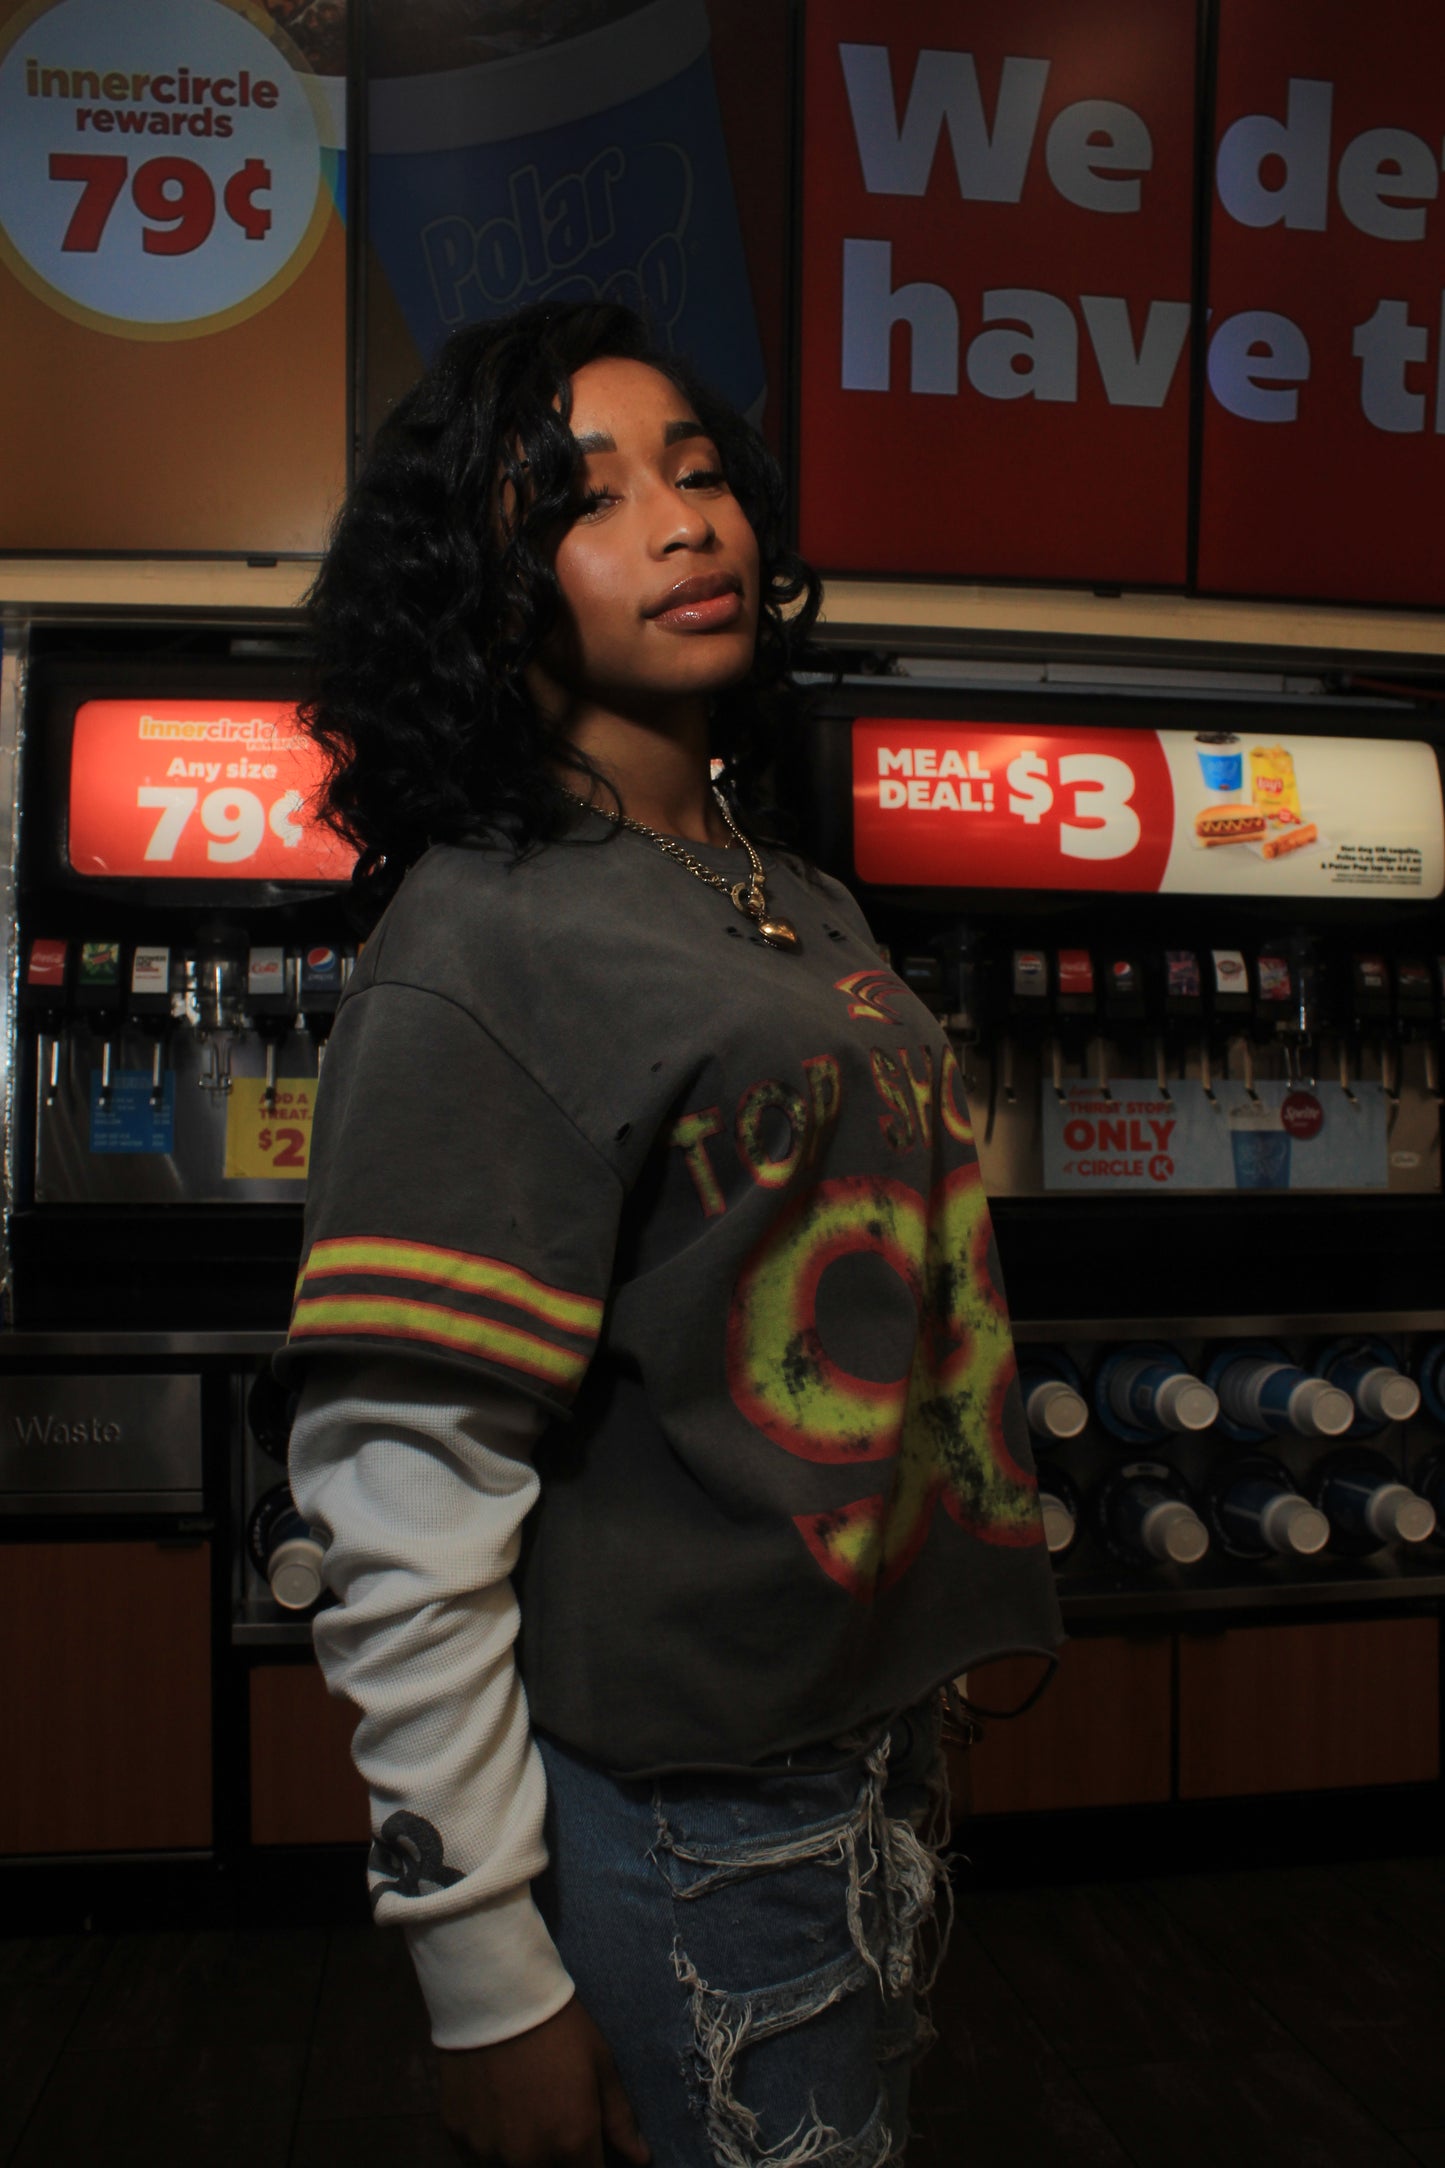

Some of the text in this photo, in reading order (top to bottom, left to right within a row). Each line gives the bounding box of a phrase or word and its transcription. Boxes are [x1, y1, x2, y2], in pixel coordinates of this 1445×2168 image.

[27, 59, 279, 109] innercircle
[76, 107, 234, 138] rewards
[839, 42, 1445, 242] We de
[49, 153, 272, 256] 79¢
[420, 145, 627, 325] Polar
[841, 238, 1310, 423] have
[1353, 290, 1445, 435] t
[138, 715, 278, 743] innercircle
[167, 757, 277, 783] Any size
[877, 747, 991, 779] MEAL
[878, 779, 995, 812] DEAL!
[1007, 750, 1142, 861] $3
[137, 786, 303, 864] 79¢
[297, 1092, 308, 1104] A
[1069, 1101, 1120, 1114] THIRST
[258, 1127, 305, 1167] $2
[668, 1054, 842, 1218] TOP
[1063, 1119, 1176, 1152] ONLY
[1077, 1159, 1144, 1176] CIRCLE
[1149, 1155, 1174, 1181] K
[12, 1415, 121, 1445] Waste
